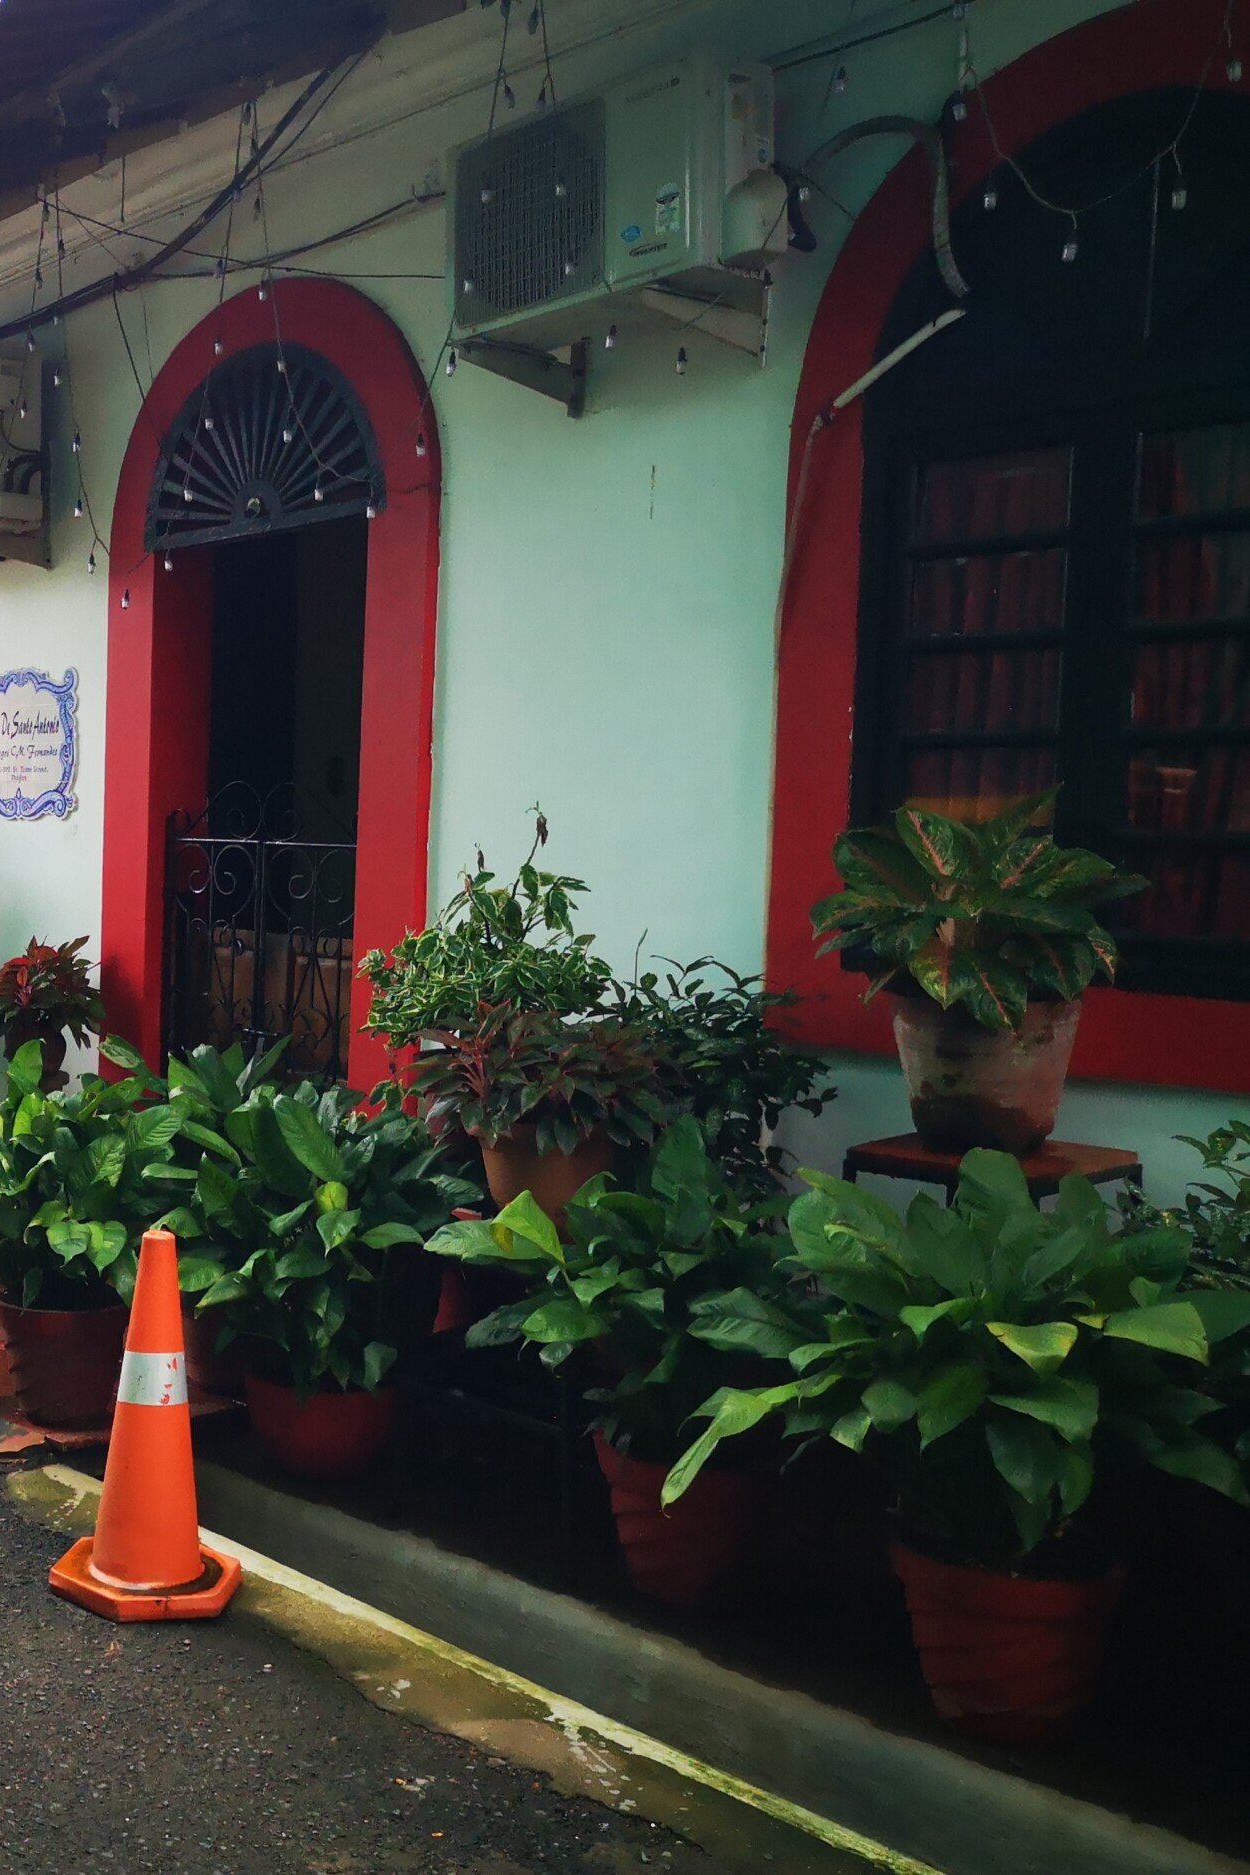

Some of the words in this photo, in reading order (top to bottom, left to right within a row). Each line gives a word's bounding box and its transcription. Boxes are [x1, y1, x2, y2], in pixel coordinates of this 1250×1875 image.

[10, 711, 33, 739] Santo
[32, 711, 59, 740] Antonio
[27, 745, 57, 759] Fernandes
